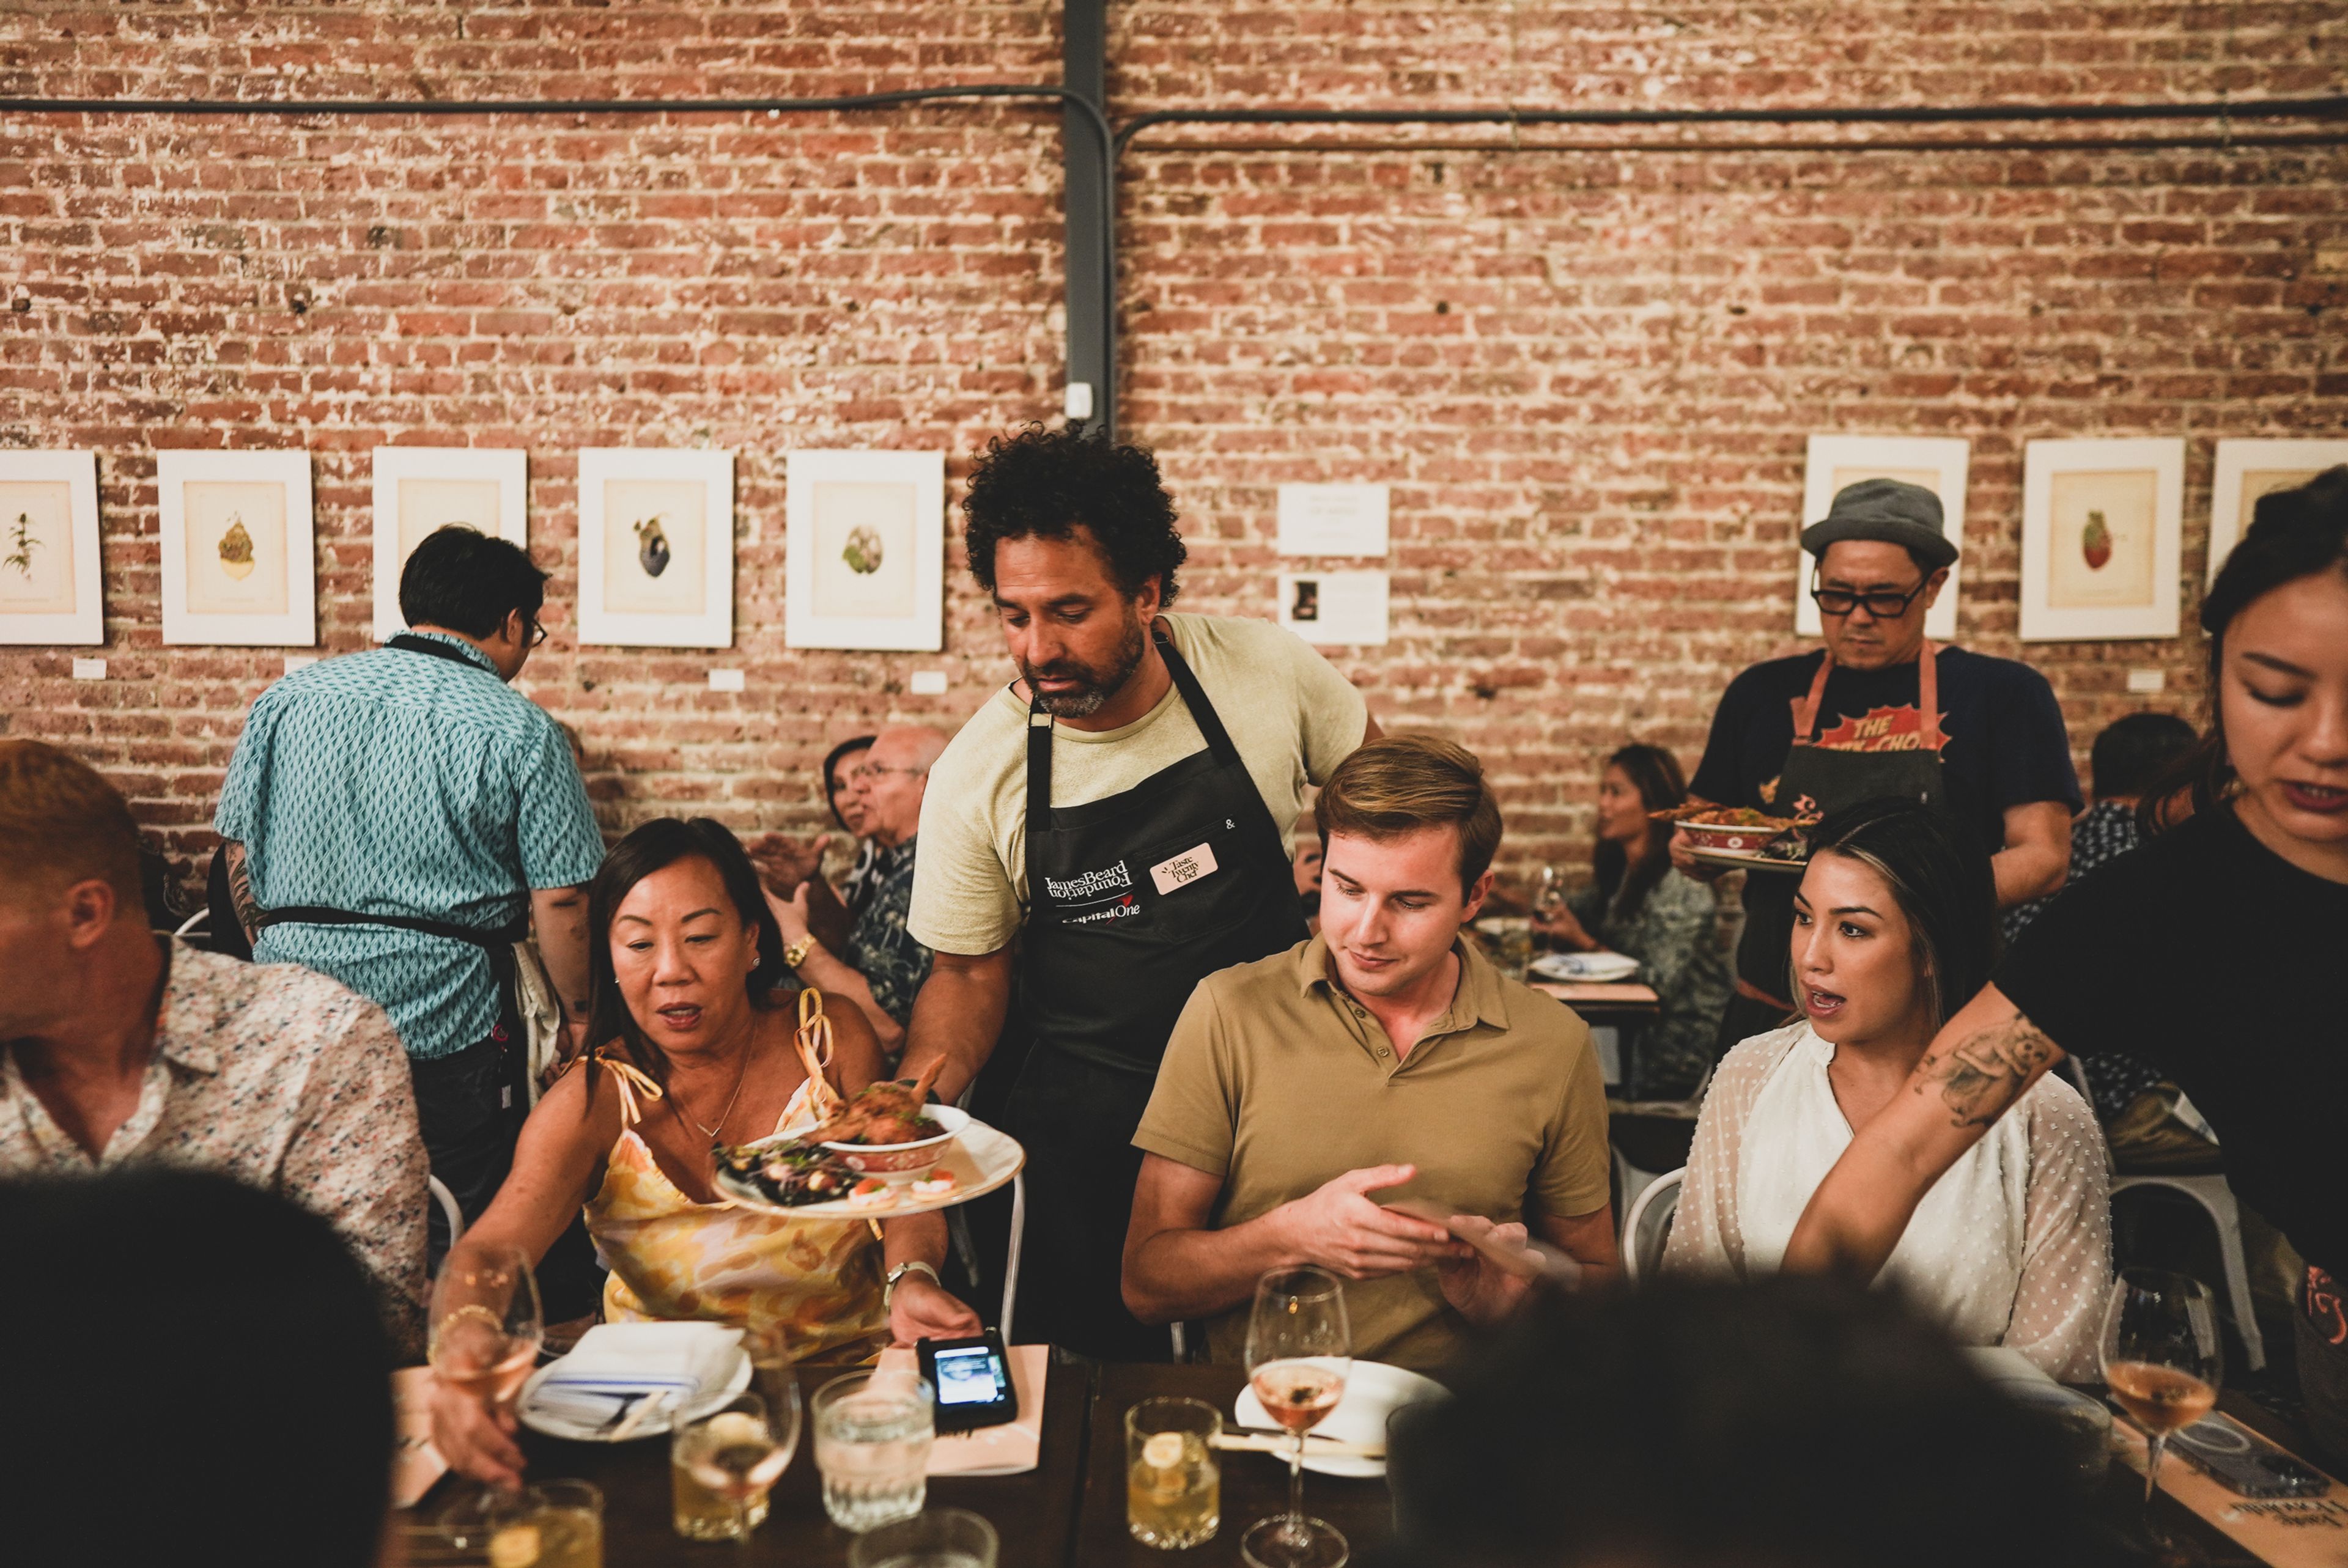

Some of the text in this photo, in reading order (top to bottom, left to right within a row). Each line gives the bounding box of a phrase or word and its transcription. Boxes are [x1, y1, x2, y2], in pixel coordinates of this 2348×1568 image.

[1854, 715, 1894, 738] THE
[1168, 861, 1199, 878] Twenty
[1169, 856, 1193, 870] Taste
[1176, 868, 1199, 883] Chef
[1048, 872, 1133, 900] Foundation
